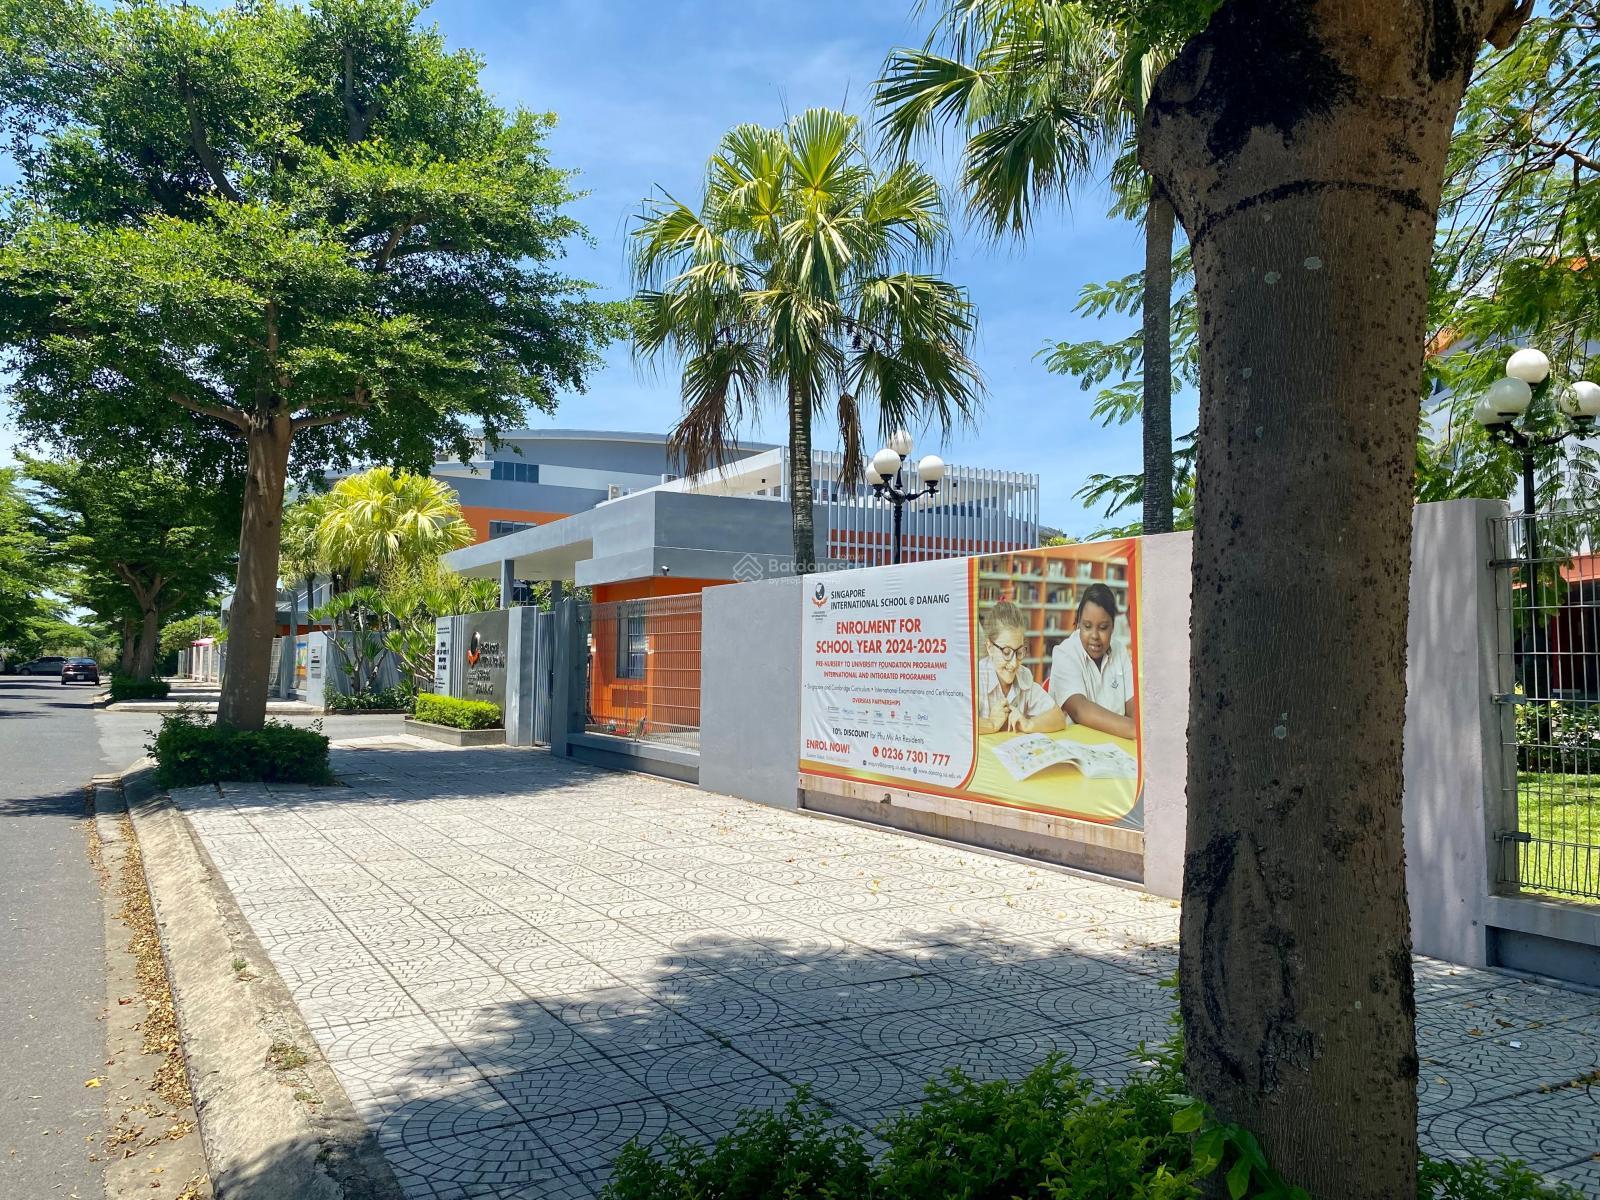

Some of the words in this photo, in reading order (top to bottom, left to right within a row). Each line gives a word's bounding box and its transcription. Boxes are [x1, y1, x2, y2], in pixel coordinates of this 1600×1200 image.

[830, 589, 866, 600] SINGAPORE
[830, 598, 879, 610] INTERNATIONAL
[880, 596, 908, 608] SCHOOL
[916, 594, 950, 605] DANANG
[836, 620, 897, 634] ENROLMENT
[900, 618, 922, 632] FOR
[816, 640, 854, 654] SCHOOL
[856, 640, 882, 654] YEAR
[886, 639, 948, 654] 2024-2025
[879, 661, 912, 669] FOUNDATION
[912, 662, 948, 670] PROGRAMME
[824, 671, 858, 679] INTERNATIONAL
[870, 672, 898, 680] INTEGRATED
[900, 673, 936, 681] PROGRAMMES
[874, 685, 898, 694] International
[898, 686, 926, 695] Examinations
[926, 688, 934, 696] and
[935, 688, 964, 697] Certifications
[832, 728, 843, 736] 10%
[844, 729, 870, 738] DISCOUNT
[806, 739, 828, 751] ENROL
[829, 742, 850, 754] NOW!
[881, 747, 904, 761] 0236
[906, 750, 928, 764] 7301
[932, 754, 951, 767] 777
